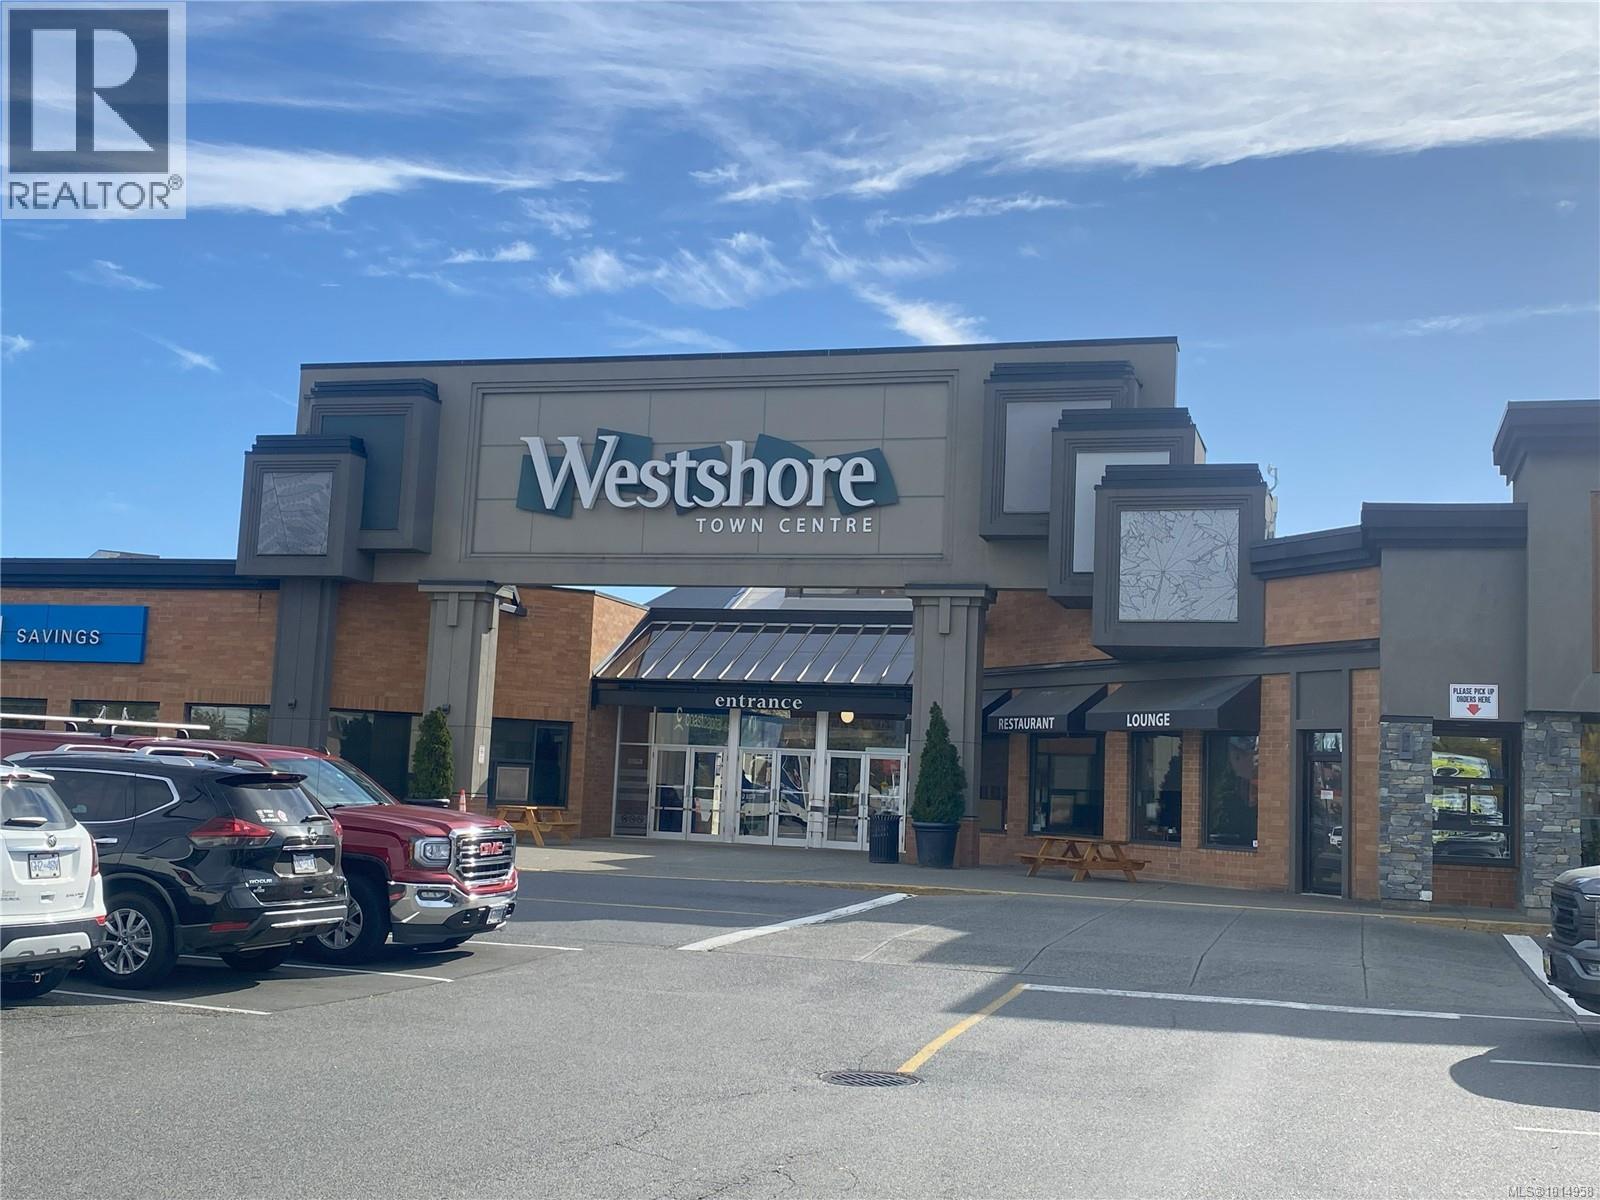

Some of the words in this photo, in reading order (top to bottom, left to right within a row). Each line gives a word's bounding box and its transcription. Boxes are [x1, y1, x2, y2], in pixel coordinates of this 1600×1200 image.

[519, 435, 877, 510] Westshore
[695, 517, 764, 534] TOWN
[779, 517, 873, 534] CENTRE
[16, 628, 100, 645] SAVINGS
[714, 693, 804, 711] entrance
[998, 716, 1055, 731] RESTAURANT
[1126, 712, 1170, 728] LOUNGE
[479, 841, 503, 857] GMC
